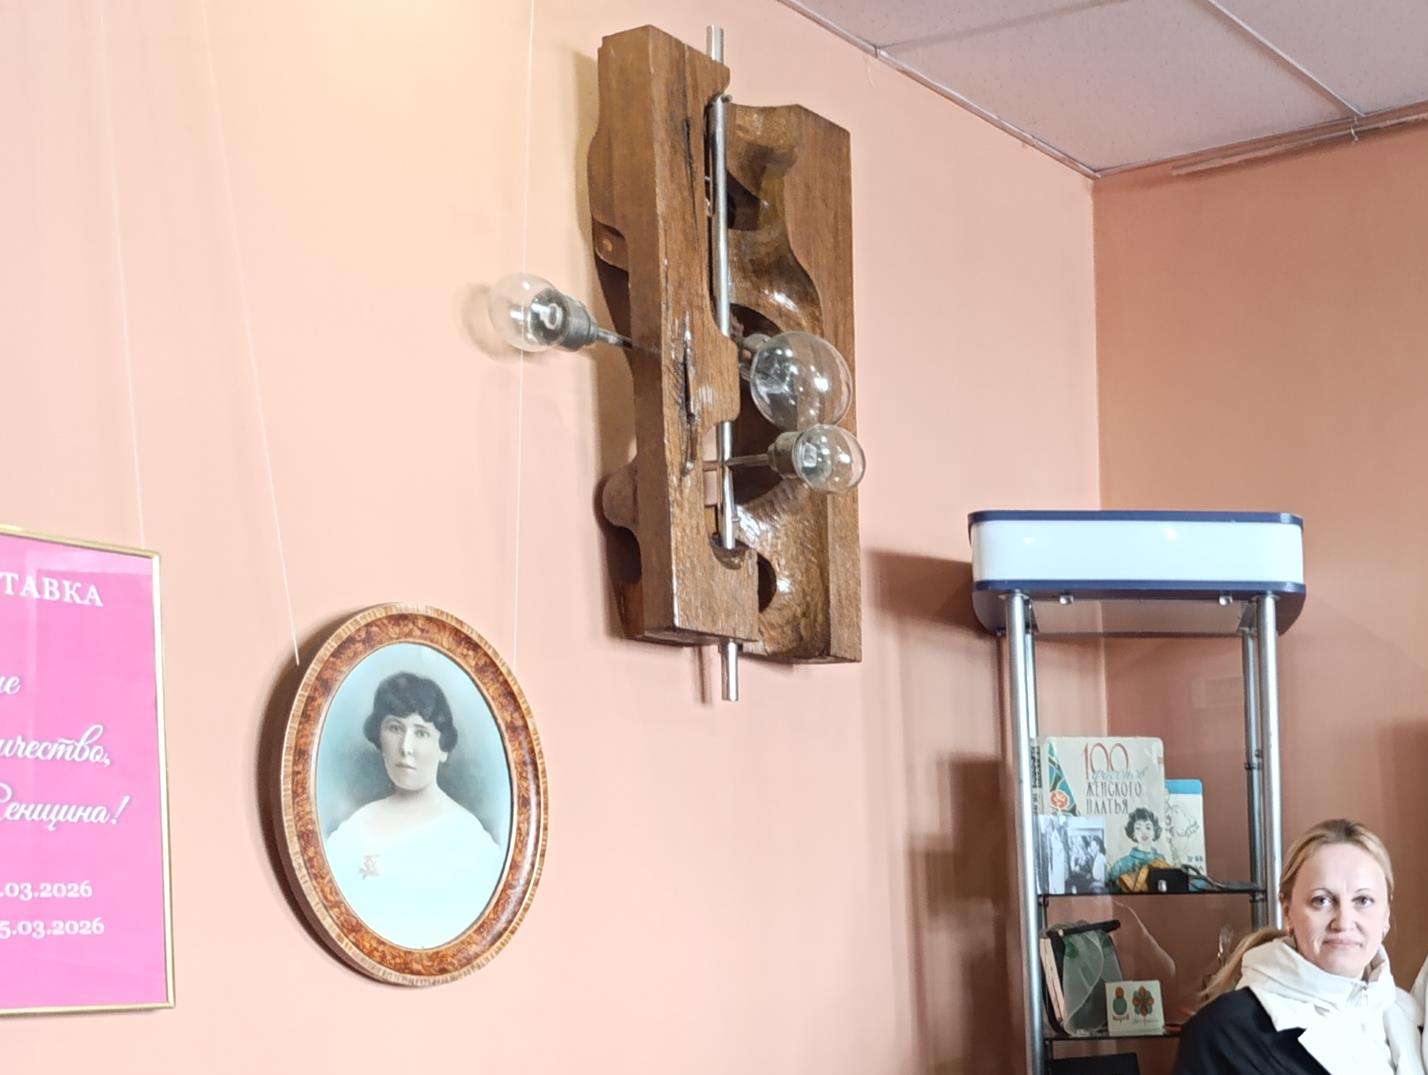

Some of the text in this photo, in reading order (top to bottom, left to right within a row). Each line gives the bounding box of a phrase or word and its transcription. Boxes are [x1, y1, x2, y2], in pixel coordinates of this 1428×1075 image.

[1083, 743, 1129, 781] 100
[1086, 781, 1142, 798] ЖЕНСКОГО
[1086, 798, 1129, 815] ПЛАТЬЯ
